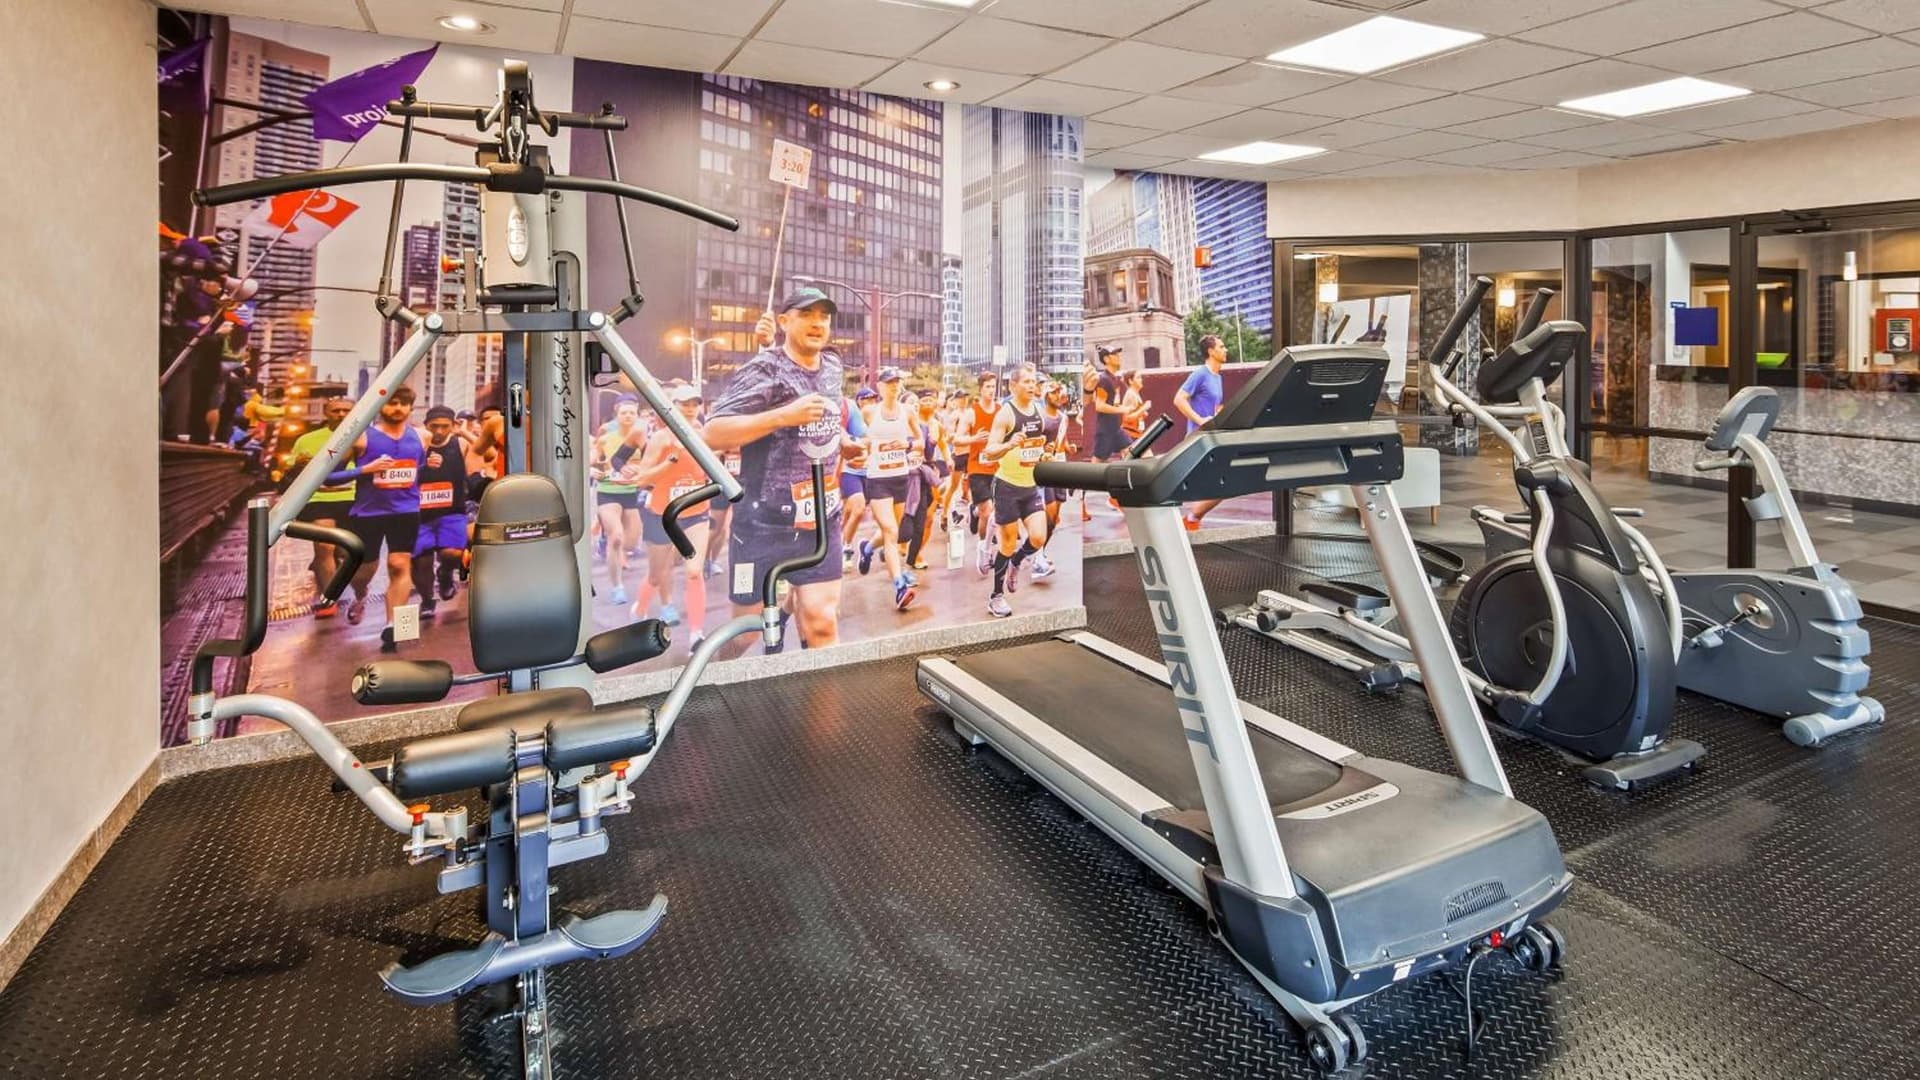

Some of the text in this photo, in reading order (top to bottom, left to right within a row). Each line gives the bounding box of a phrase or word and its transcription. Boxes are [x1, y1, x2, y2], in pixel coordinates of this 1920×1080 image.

[553, 336, 576, 460] Body-Solid
[1134, 546, 1220, 763] SPIRIT
[1325, 791, 1379, 812] SPIRIT
